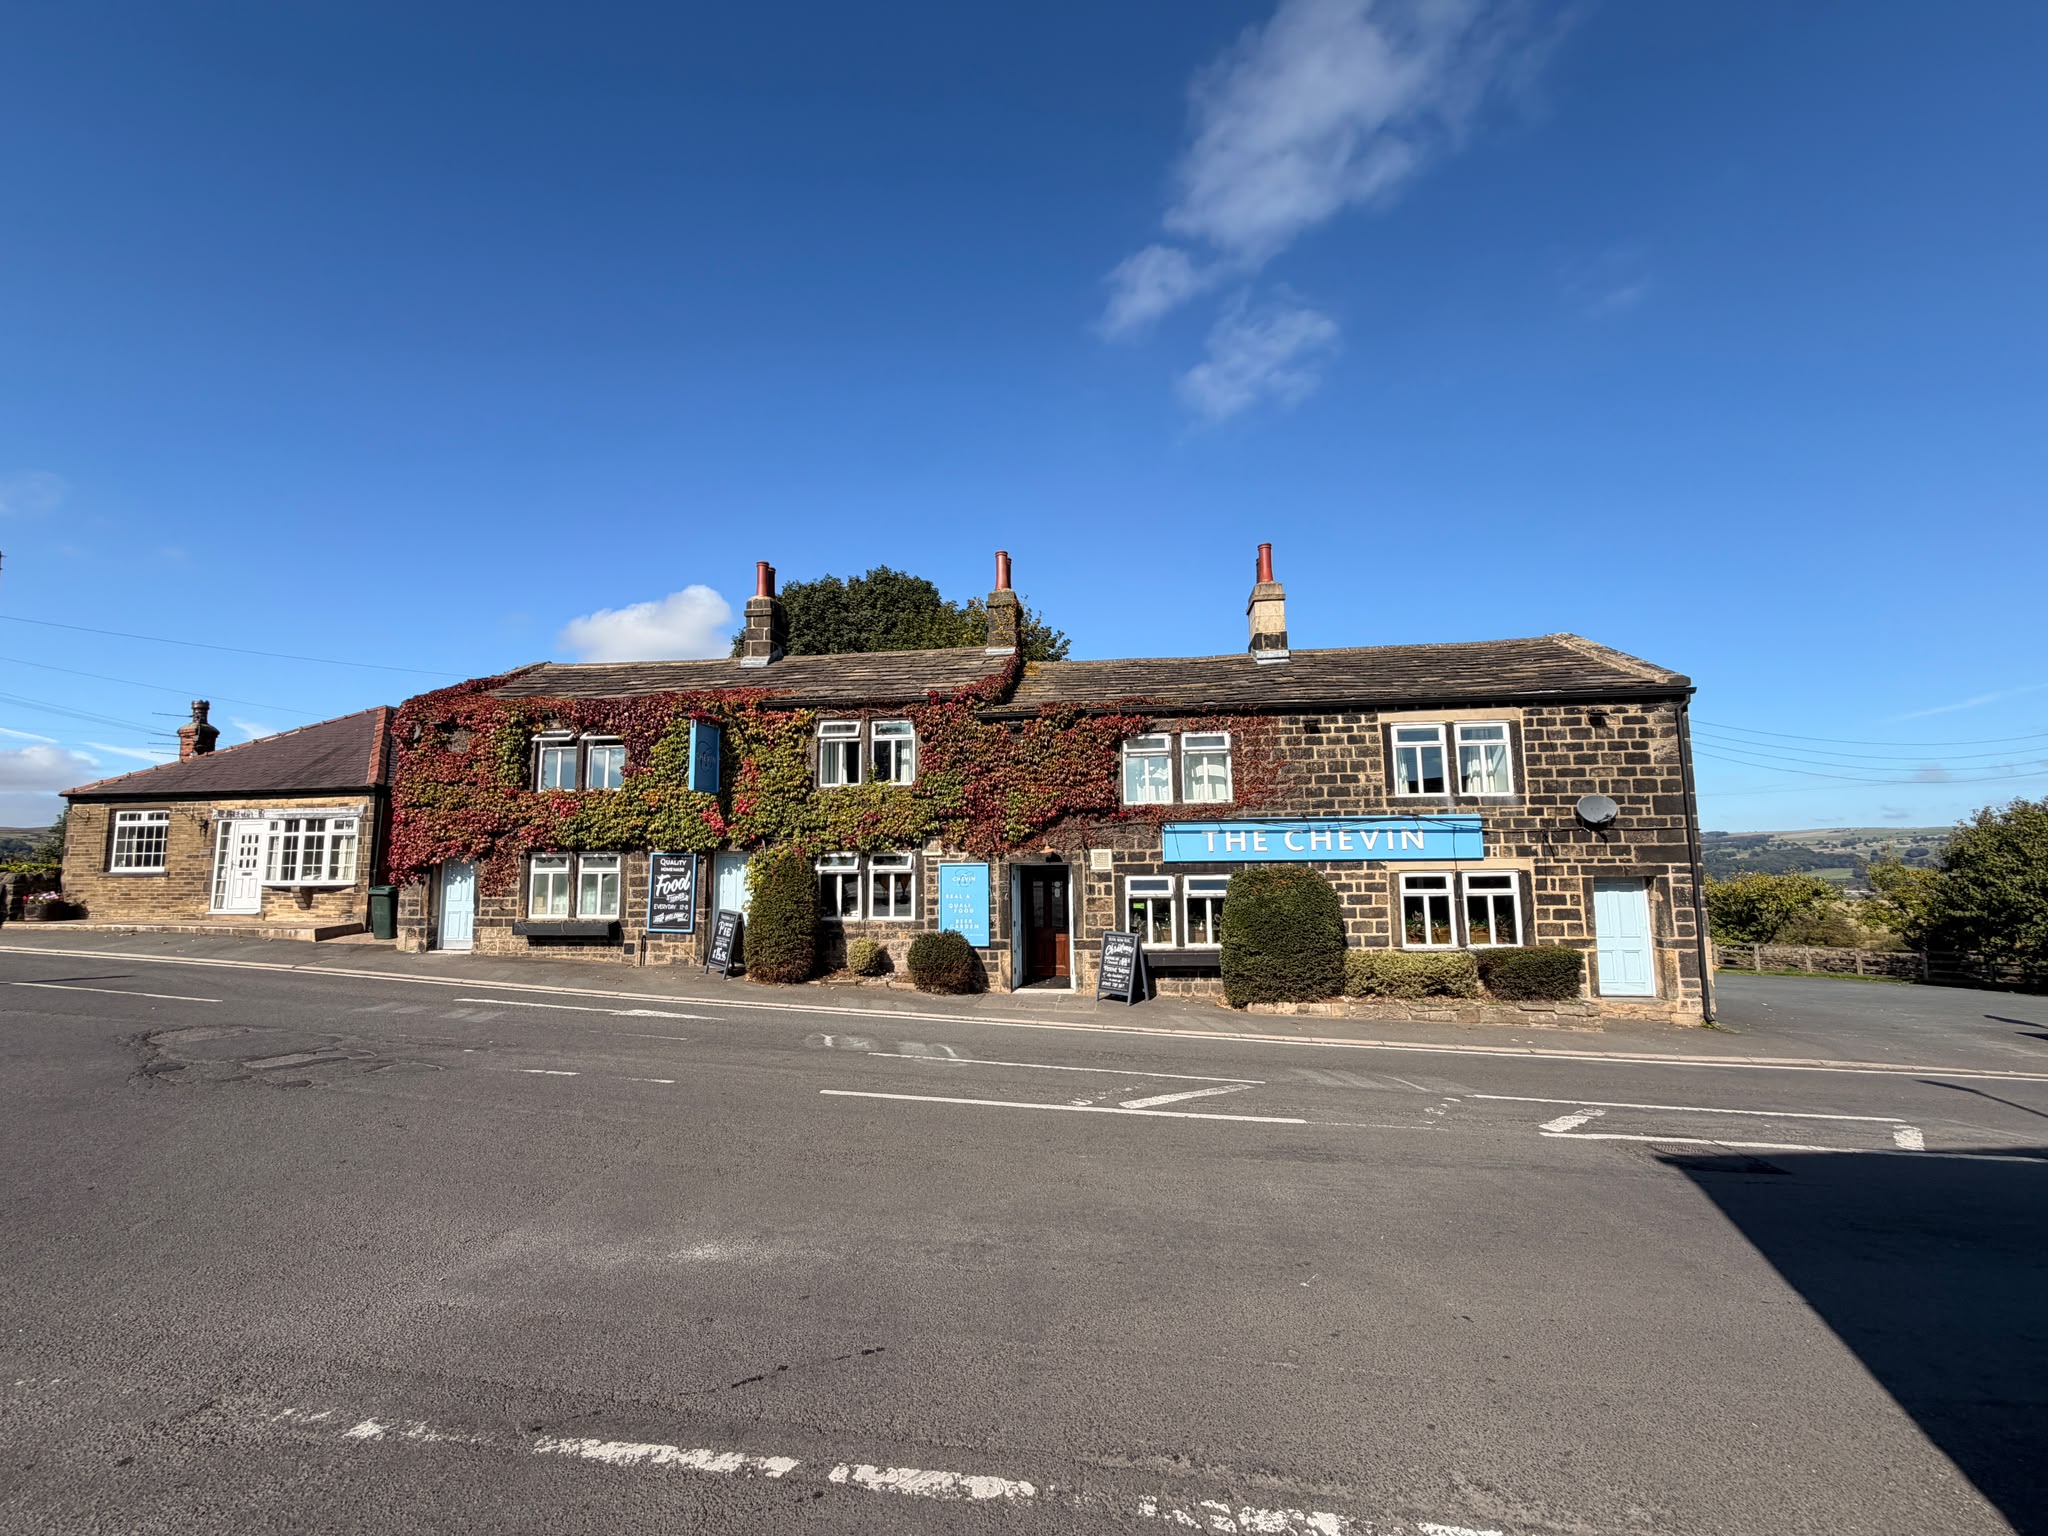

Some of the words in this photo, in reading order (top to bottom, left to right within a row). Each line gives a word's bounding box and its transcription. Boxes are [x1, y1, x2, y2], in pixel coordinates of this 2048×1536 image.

[1202, 830, 1268, 852] THE
[1284, 826, 1425, 852] CHEVIN
[660, 858, 687, 867] QUALITY
[655, 870, 691, 897] Food
